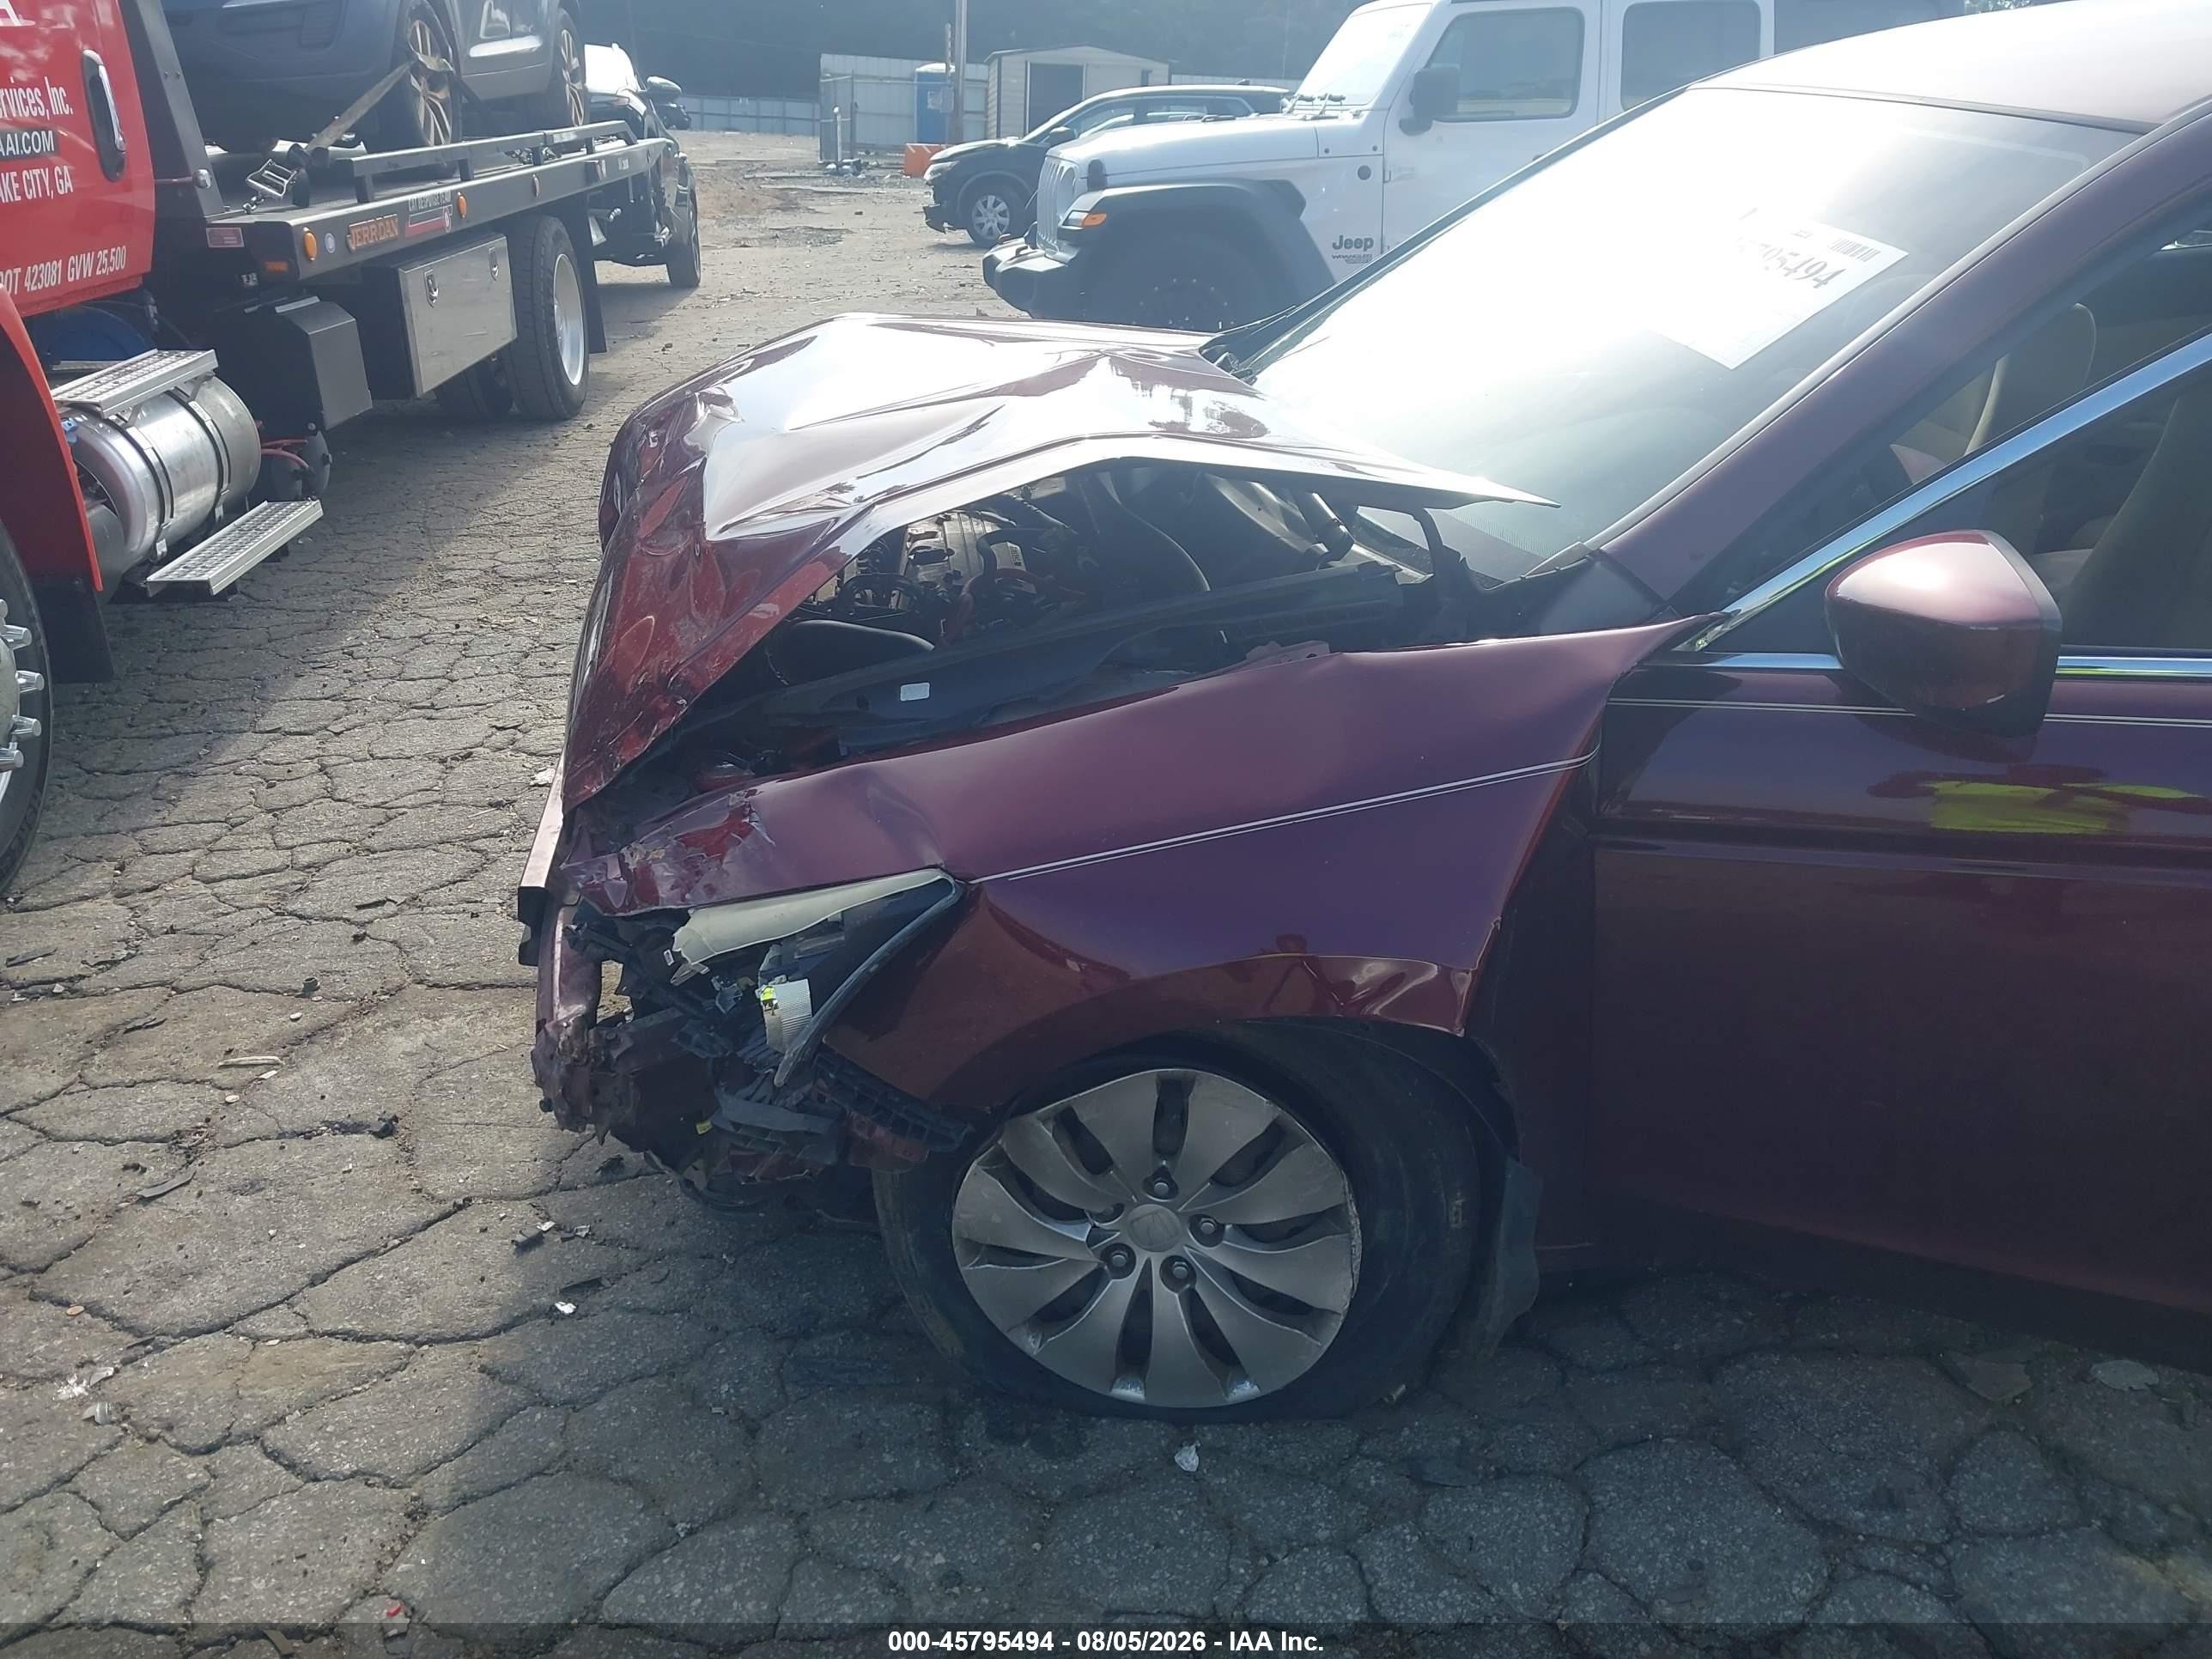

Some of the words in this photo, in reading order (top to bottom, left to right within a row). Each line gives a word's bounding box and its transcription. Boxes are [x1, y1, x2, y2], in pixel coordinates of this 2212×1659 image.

[44, 76, 74, 115] Inc.
[21, 167, 54, 200] CITY,
[54, 165, 74, 195] GA
[1332, 234, 1374, 252] Jeep
[24, 258, 63, 292] 423081
[67, 251, 95, 283] GVW
[95, 245, 126, 276] 25,500
